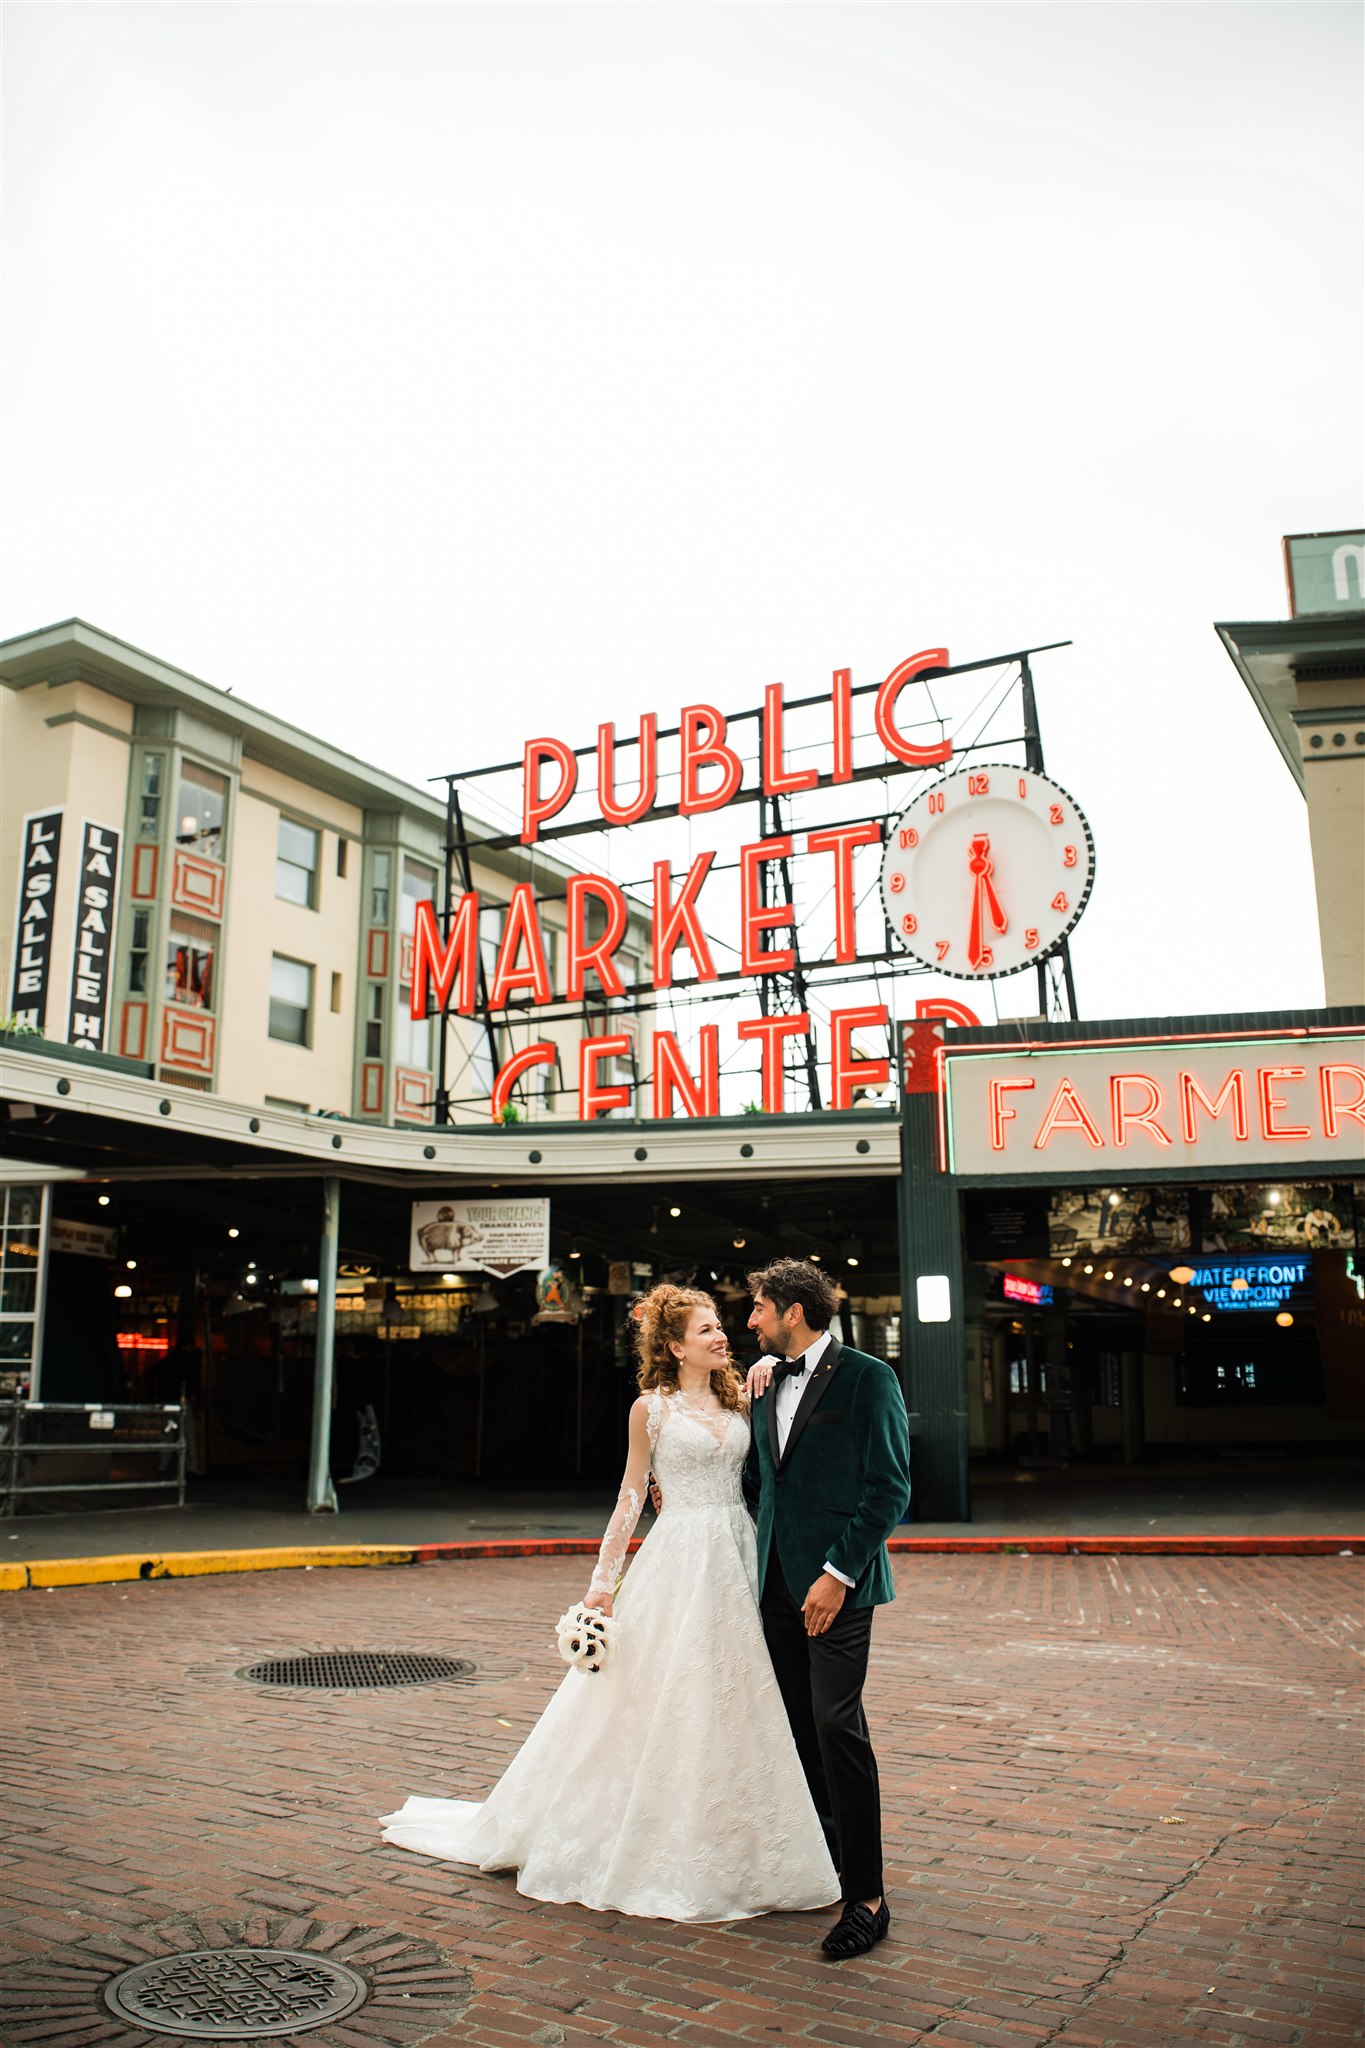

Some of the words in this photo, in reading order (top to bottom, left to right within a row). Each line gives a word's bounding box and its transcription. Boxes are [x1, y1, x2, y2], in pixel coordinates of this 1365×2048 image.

[520, 648, 953, 844] PUBLIC
[968, 773, 989, 796] 12
[1019, 779, 1026, 798] 1
[928, 793, 944, 814] 11
[1049, 804, 1064, 824] 2
[27, 822, 54, 868] LA
[900, 828, 918, 848] 10
[86, 827, 112, 878] LA
[1063, 845, 1077, 867] 3
[890, 873, 905, 893] 9
[1051, 891, 1068, 912] 4
[410, 822, 882, 1020] MARKET
[903, 914, 917, 934] 8
[18, 873, 52, 994] SALLE
[1025, 928, 1039, 949] 5
[76, 885, 108, 1004] SALLE
[936, 940, 950, 960] 7
[989, 1064, 1365, 1150] FARMER
[467, 1207, 496, 1222] YOUR
[1203, 1285, 1292, 1302] VIEWPOINT
